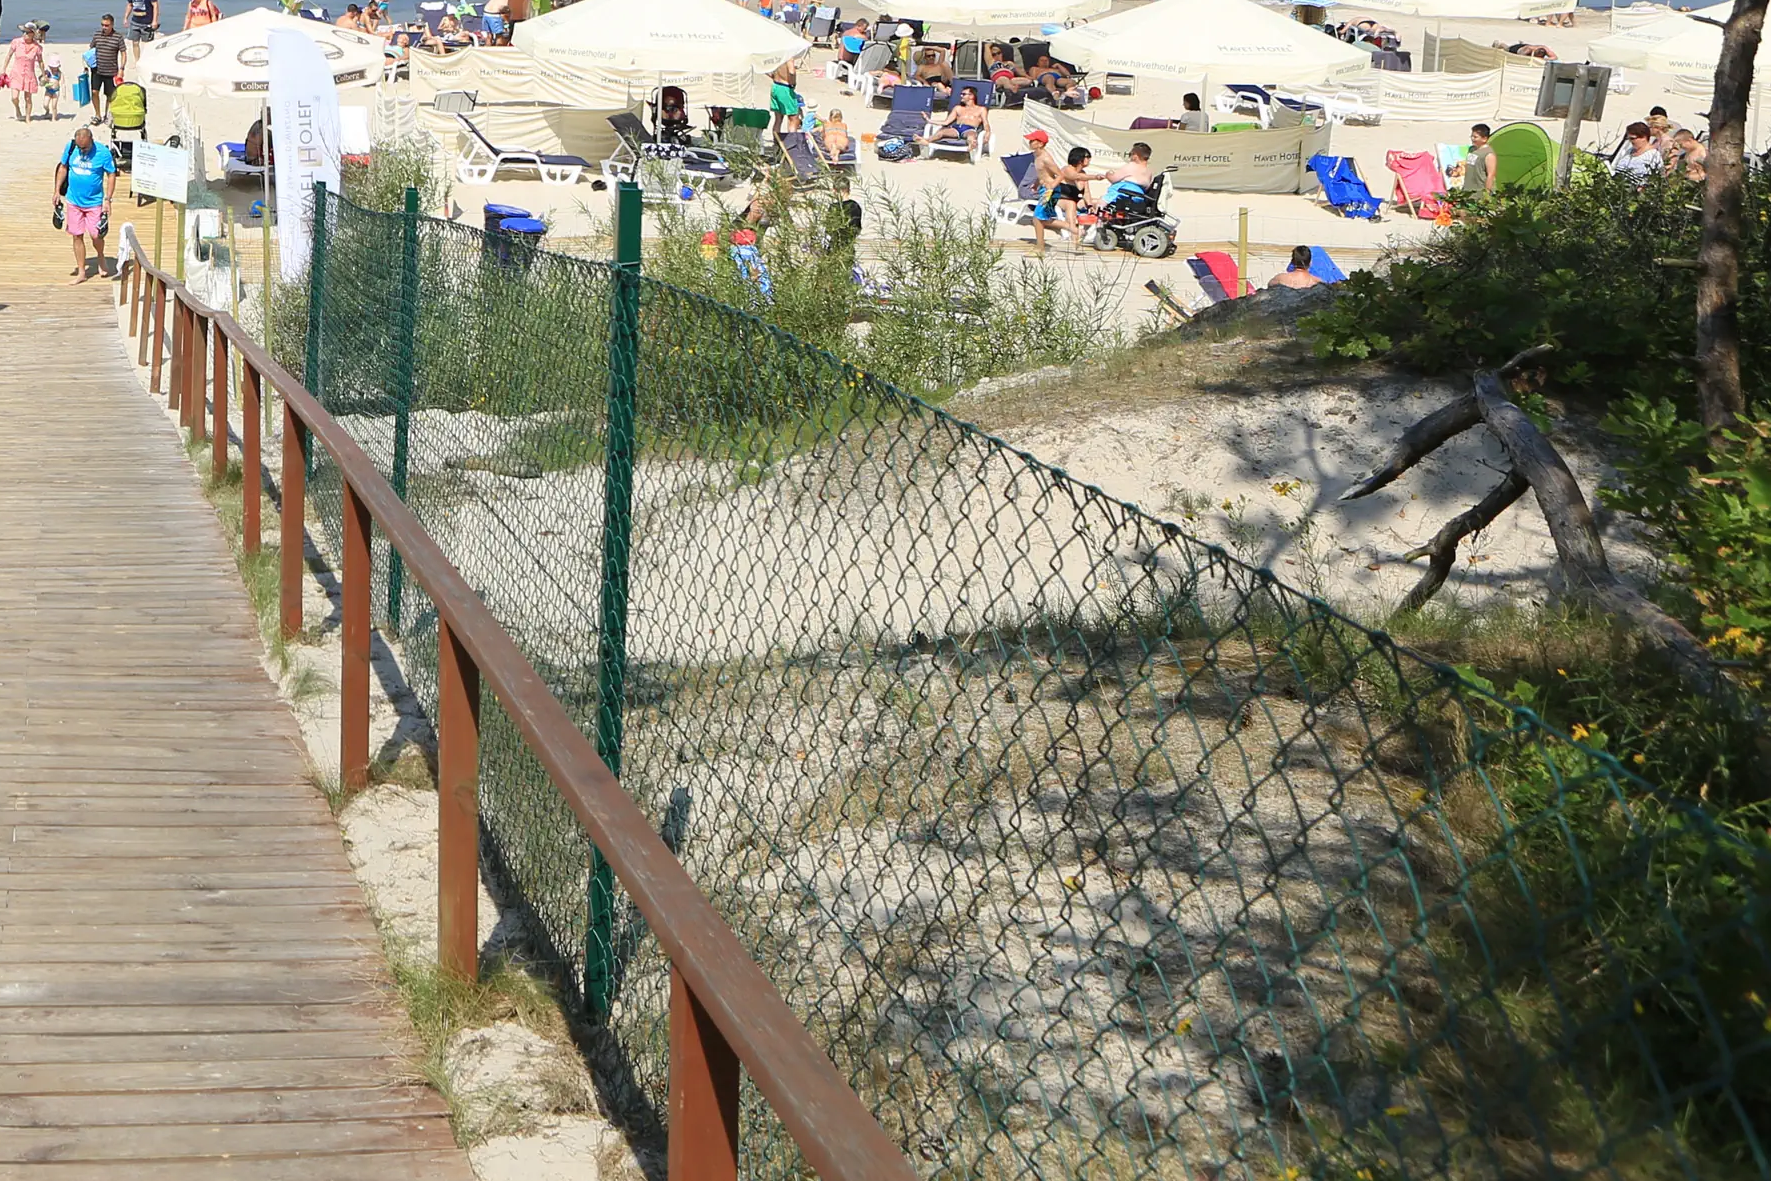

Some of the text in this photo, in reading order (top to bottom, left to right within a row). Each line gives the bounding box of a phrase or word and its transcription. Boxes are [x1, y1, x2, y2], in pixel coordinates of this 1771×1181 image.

[991, 11, 1055, 19] www.havethotel.pl
[650, 31, 685, 39] HAVET
[548, 46, 617, 60] www.havethotel.pl
[1257, 45, 1291, 53] HOTEL
[1107, 58, 1187, 73] www.havethotel.pl
[335, 72, 360, 84] Colberg
[240, 82, 270, 91] Colber
[1174, 154, 1231, 162] HAVET HOTEL
[1253, 154, 1277, 162] HAVET
